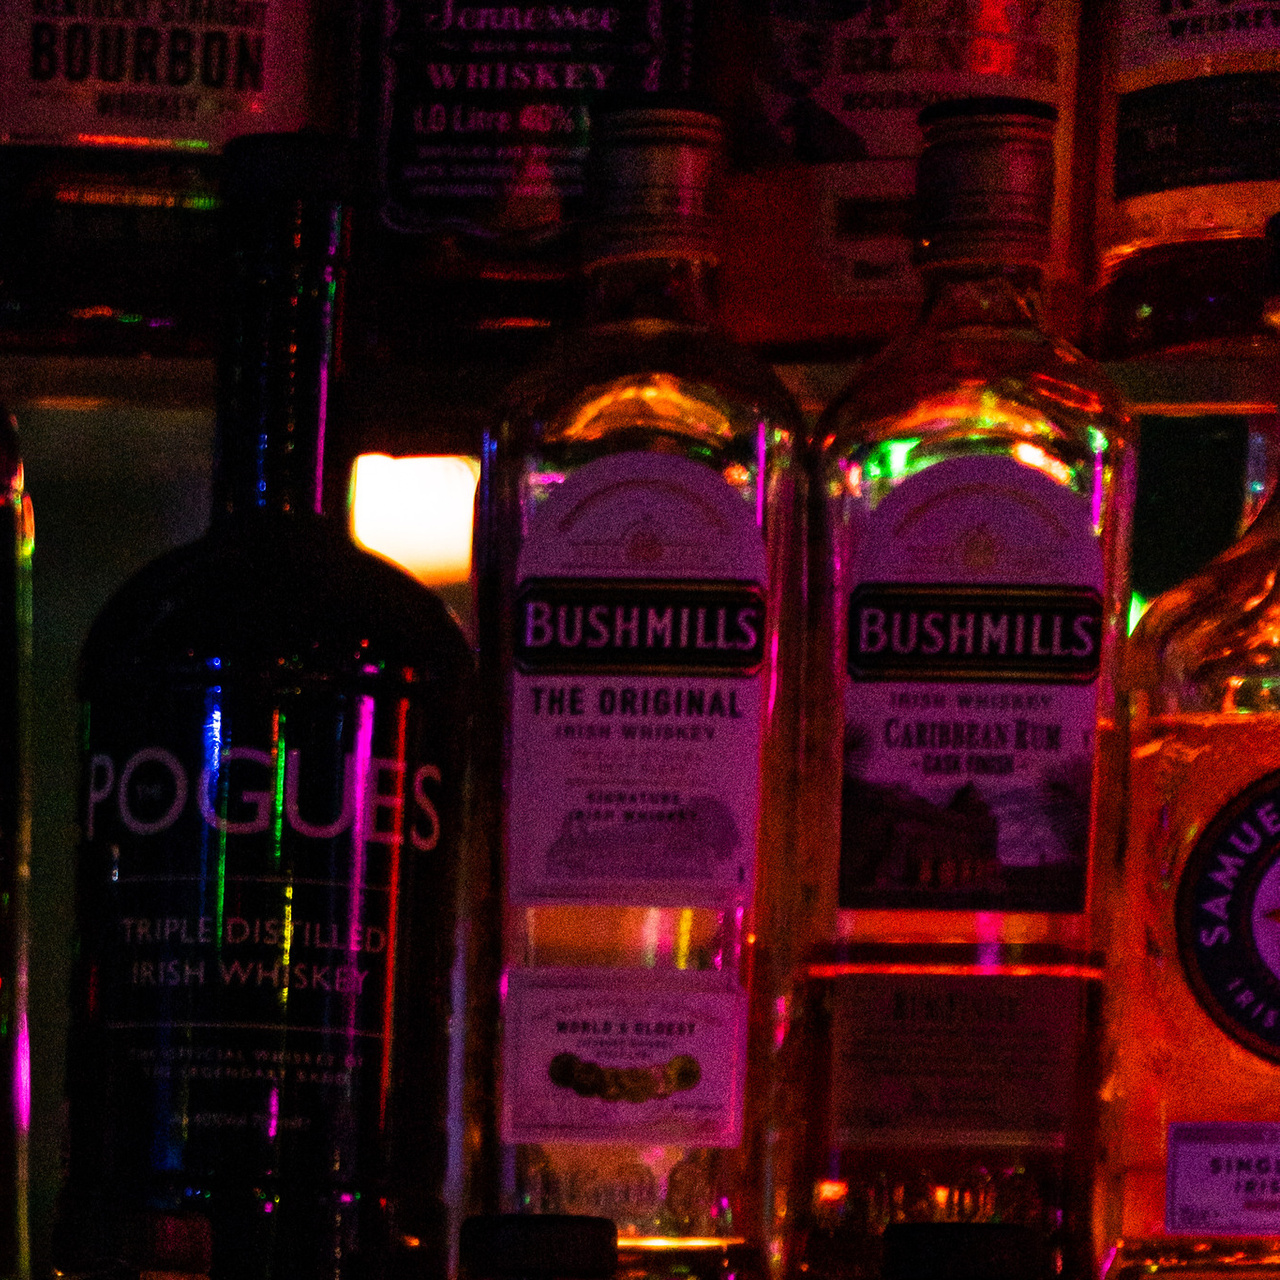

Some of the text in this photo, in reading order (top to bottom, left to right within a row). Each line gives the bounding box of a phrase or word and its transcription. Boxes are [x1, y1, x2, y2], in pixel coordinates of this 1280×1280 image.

[30, 24, 264, 90] BOURBON
[428, 61, 615, 91] WHISKEY
[524, 600, 760, 652] BUSHMILLS
[857, 608, 1095, 659] BUSHMILLS
[531, 687, 742, 718] THE ORIGINAL
[86, 745, 443, 852] POGUES
[122, 917, 388, 954] TRIPLE DISTILLED
[131, 959, 369, 996] IRISH WHISKEY
[1210, 1157, 1280, 1175] SING
